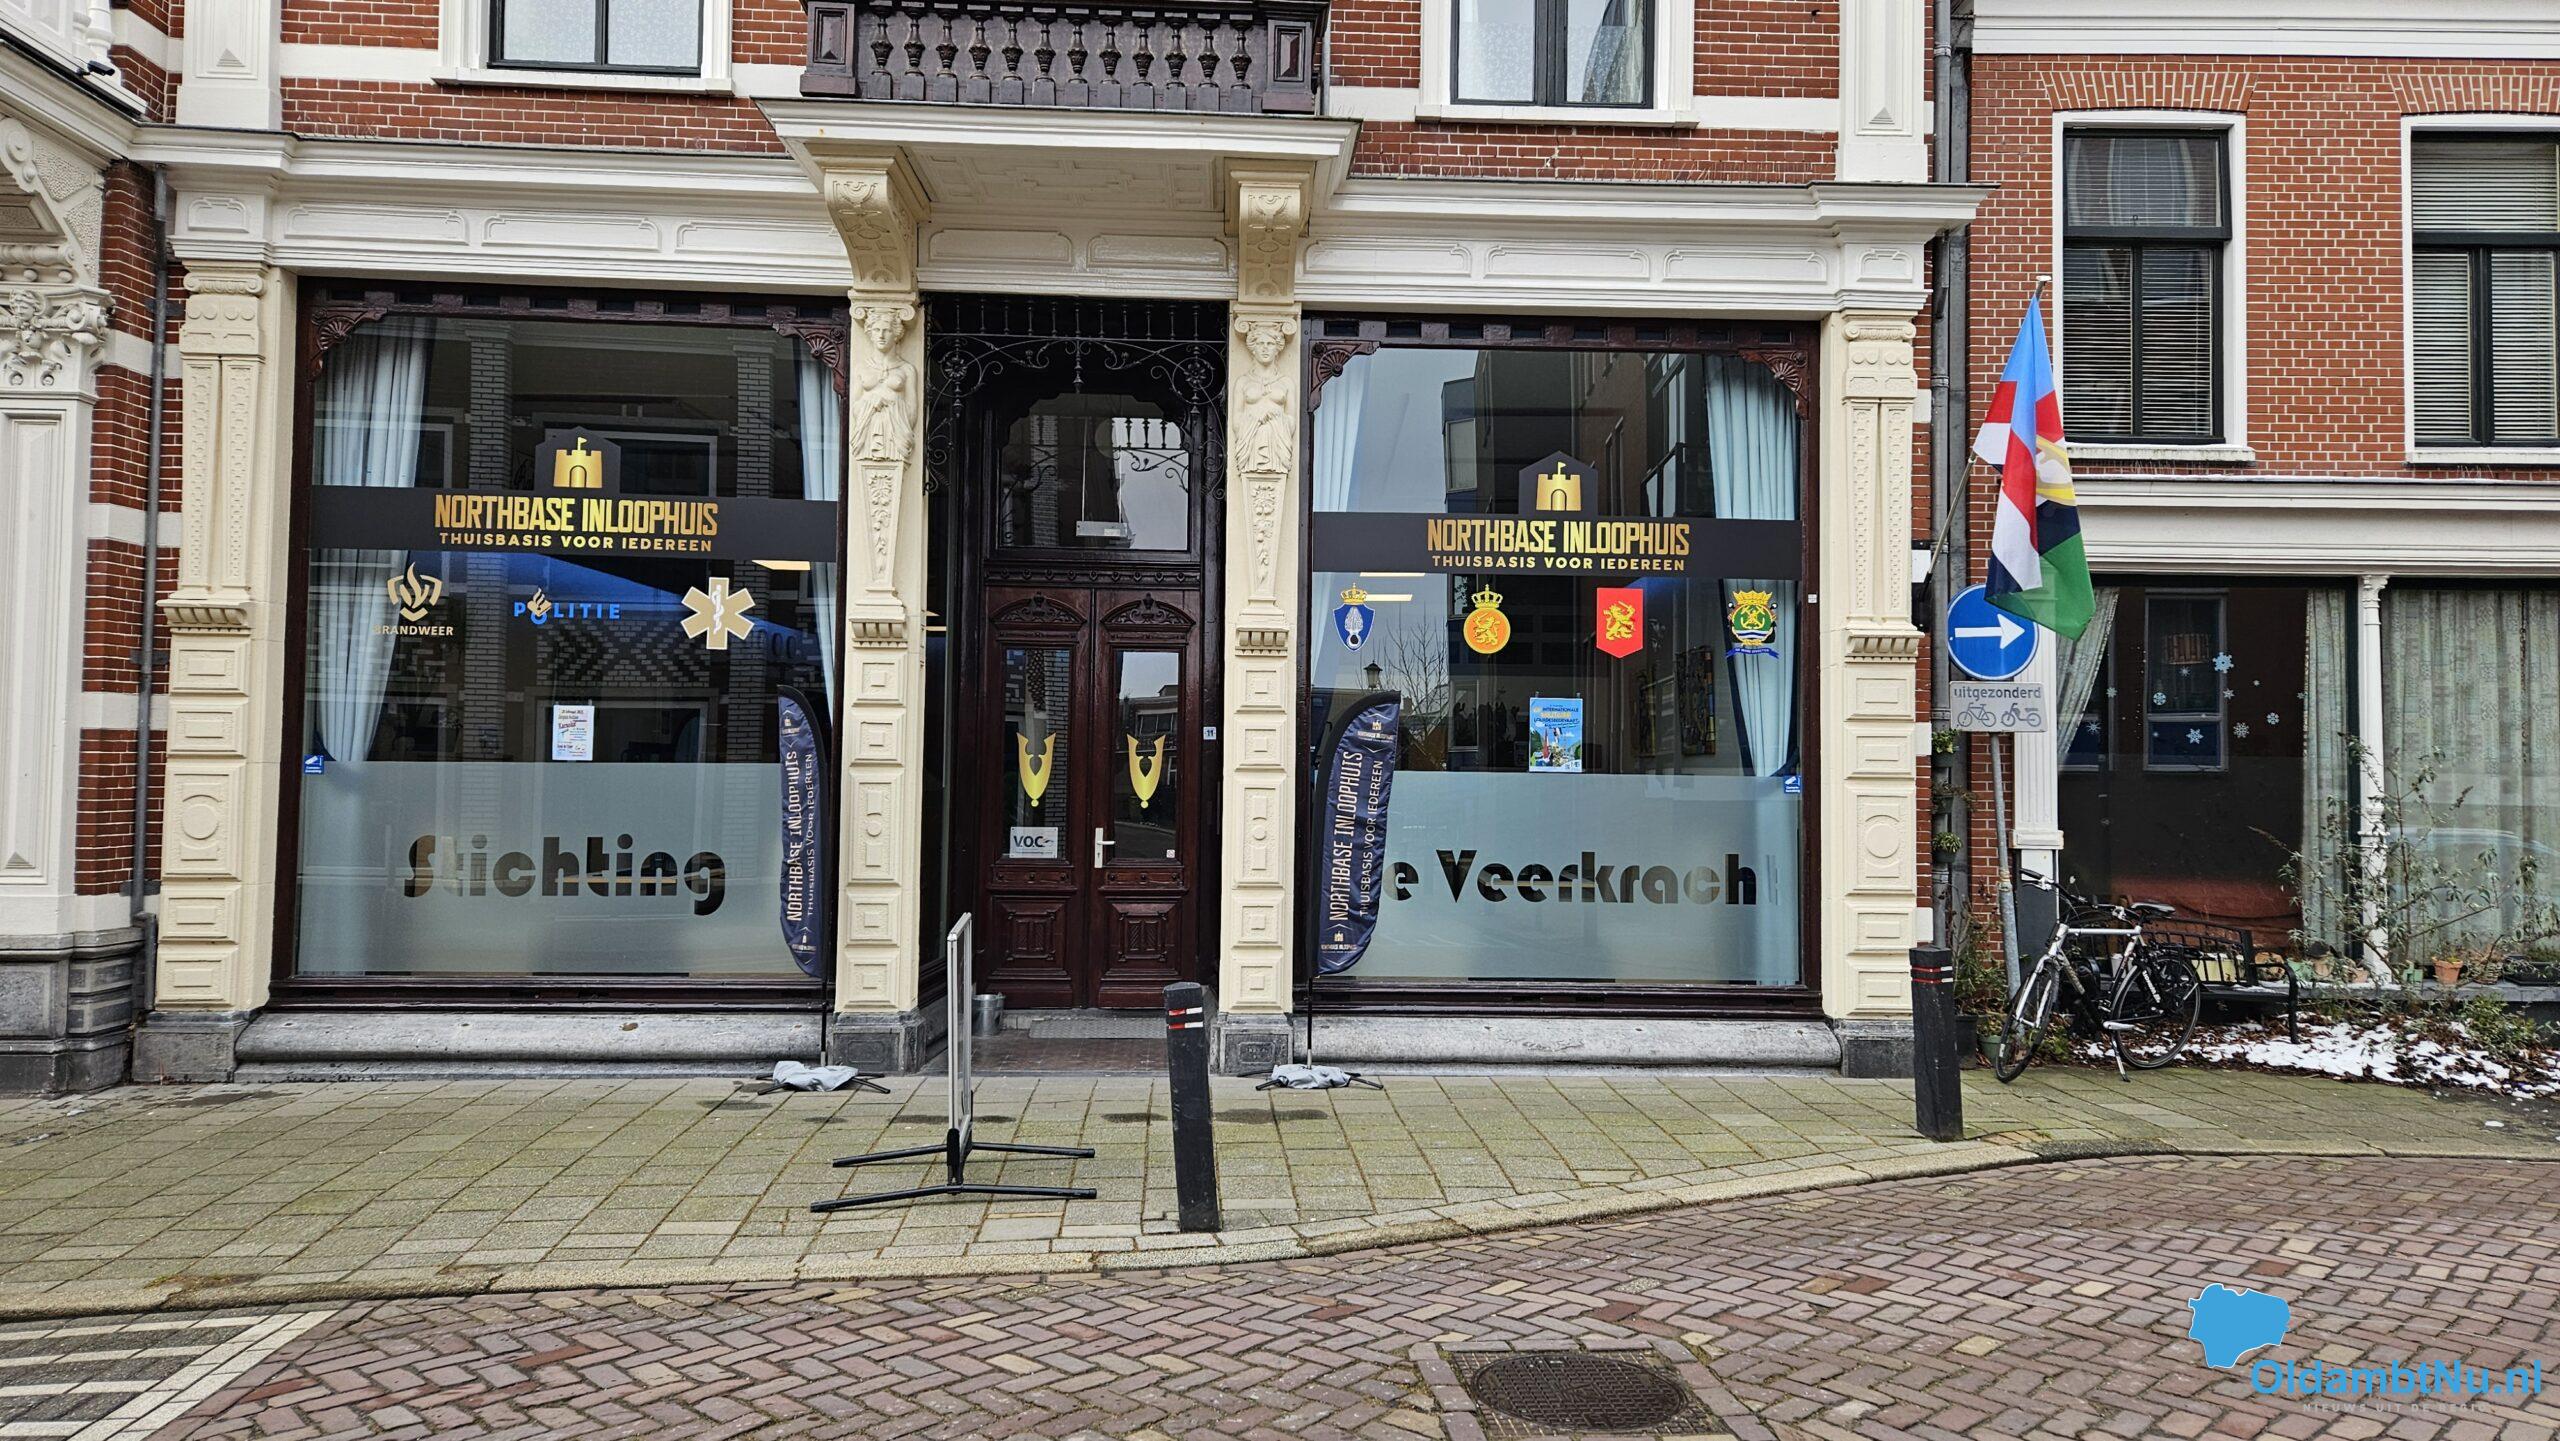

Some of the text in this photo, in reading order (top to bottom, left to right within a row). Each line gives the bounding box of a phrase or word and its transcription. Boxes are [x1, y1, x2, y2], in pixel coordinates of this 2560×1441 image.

[434, 494, 718, 536] NORTHBASE INLOOPHUIS
[439, 532, 712, 552] THUISBASIS VOOR IEDEREEN
[1427, 518, 1689, 556] NORTHBASE INLOOPHUIS
[1432, 555, 1685, 571] THUISBASIS VOOR IEDEREEN
[374, 624, 454, 636] BRANDWEER
[513, 601, 620, 625] POLITIE
[1954, 686, 2042, 702] uitgezonderd
[1206, 729, 1214, 737] 11
[785, 751, 803, 836] INLOOPHUIS
[1334, 751, 1363, 836] INLOOPHUIS
[805, 812, 814, 847] VOOR
[1359, 760, 1383, 917] THUISBASIS VOOR IEDEREEN
[403, 833, 726, 916] Stichting
[786, 841, 803, 922] NORTHBASE
[1329, 840, 1353, 921] NORTHBASE
[1383, 861, 1419, 901] e
